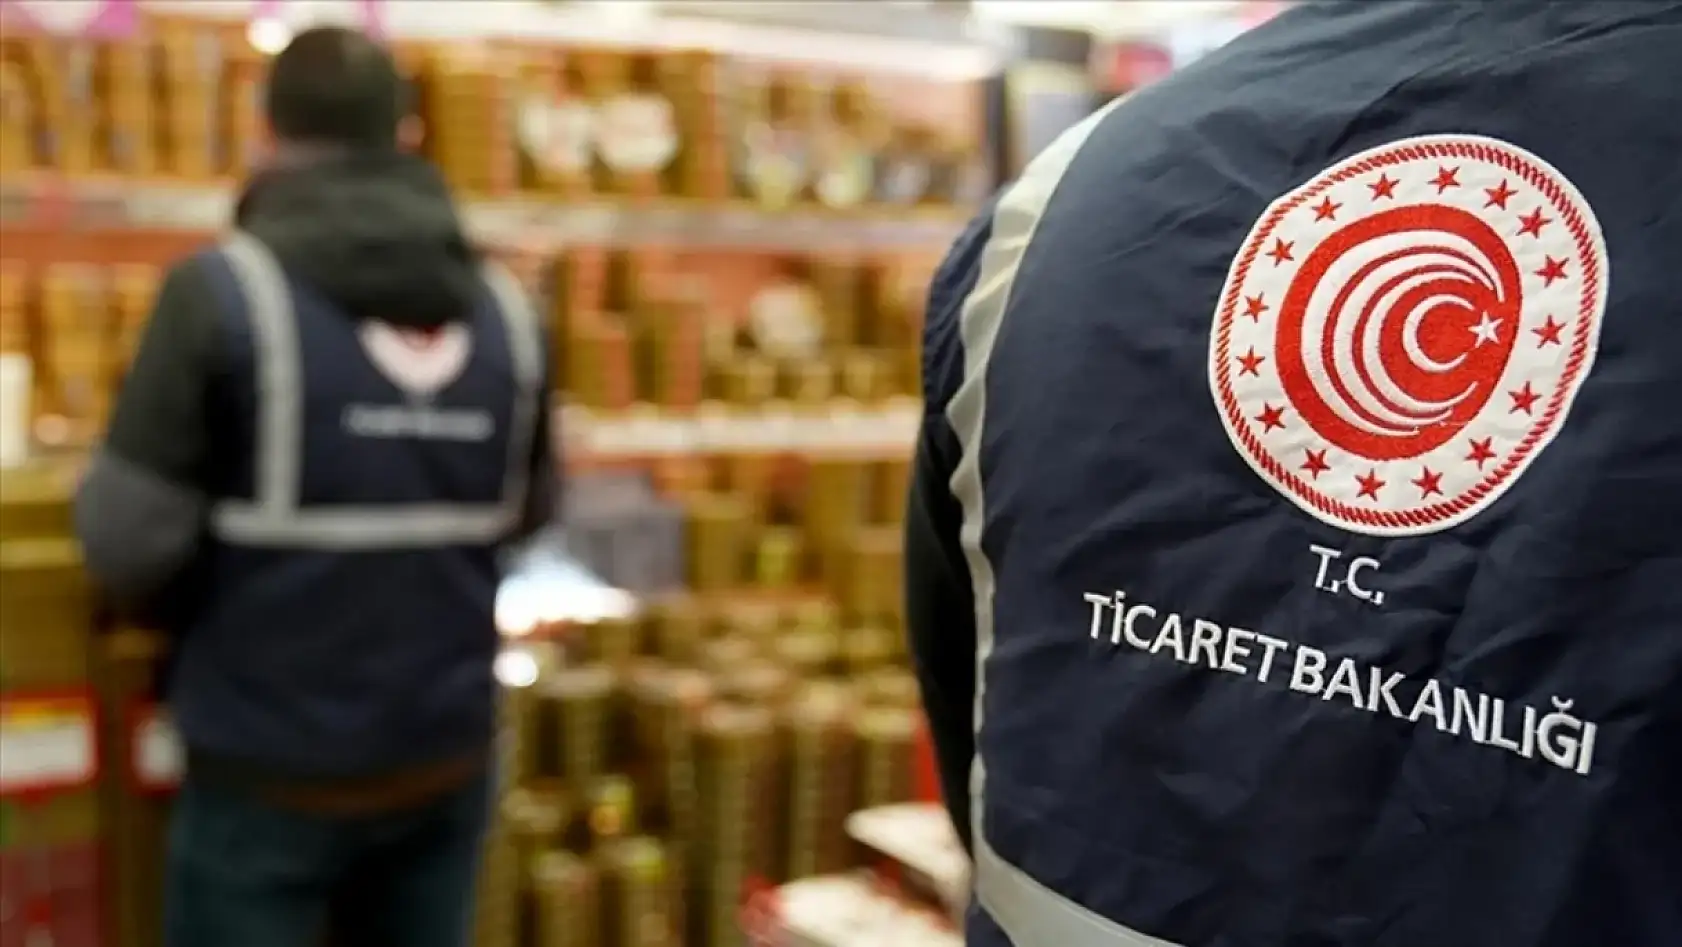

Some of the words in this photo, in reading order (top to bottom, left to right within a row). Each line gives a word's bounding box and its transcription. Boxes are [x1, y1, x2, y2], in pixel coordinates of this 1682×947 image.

[1309, 544, 1385, 605] T.C.
[1083, 590, 1288, 683] TİCARET
[1289, 645, 1598, 774] BAKANLIĞI
